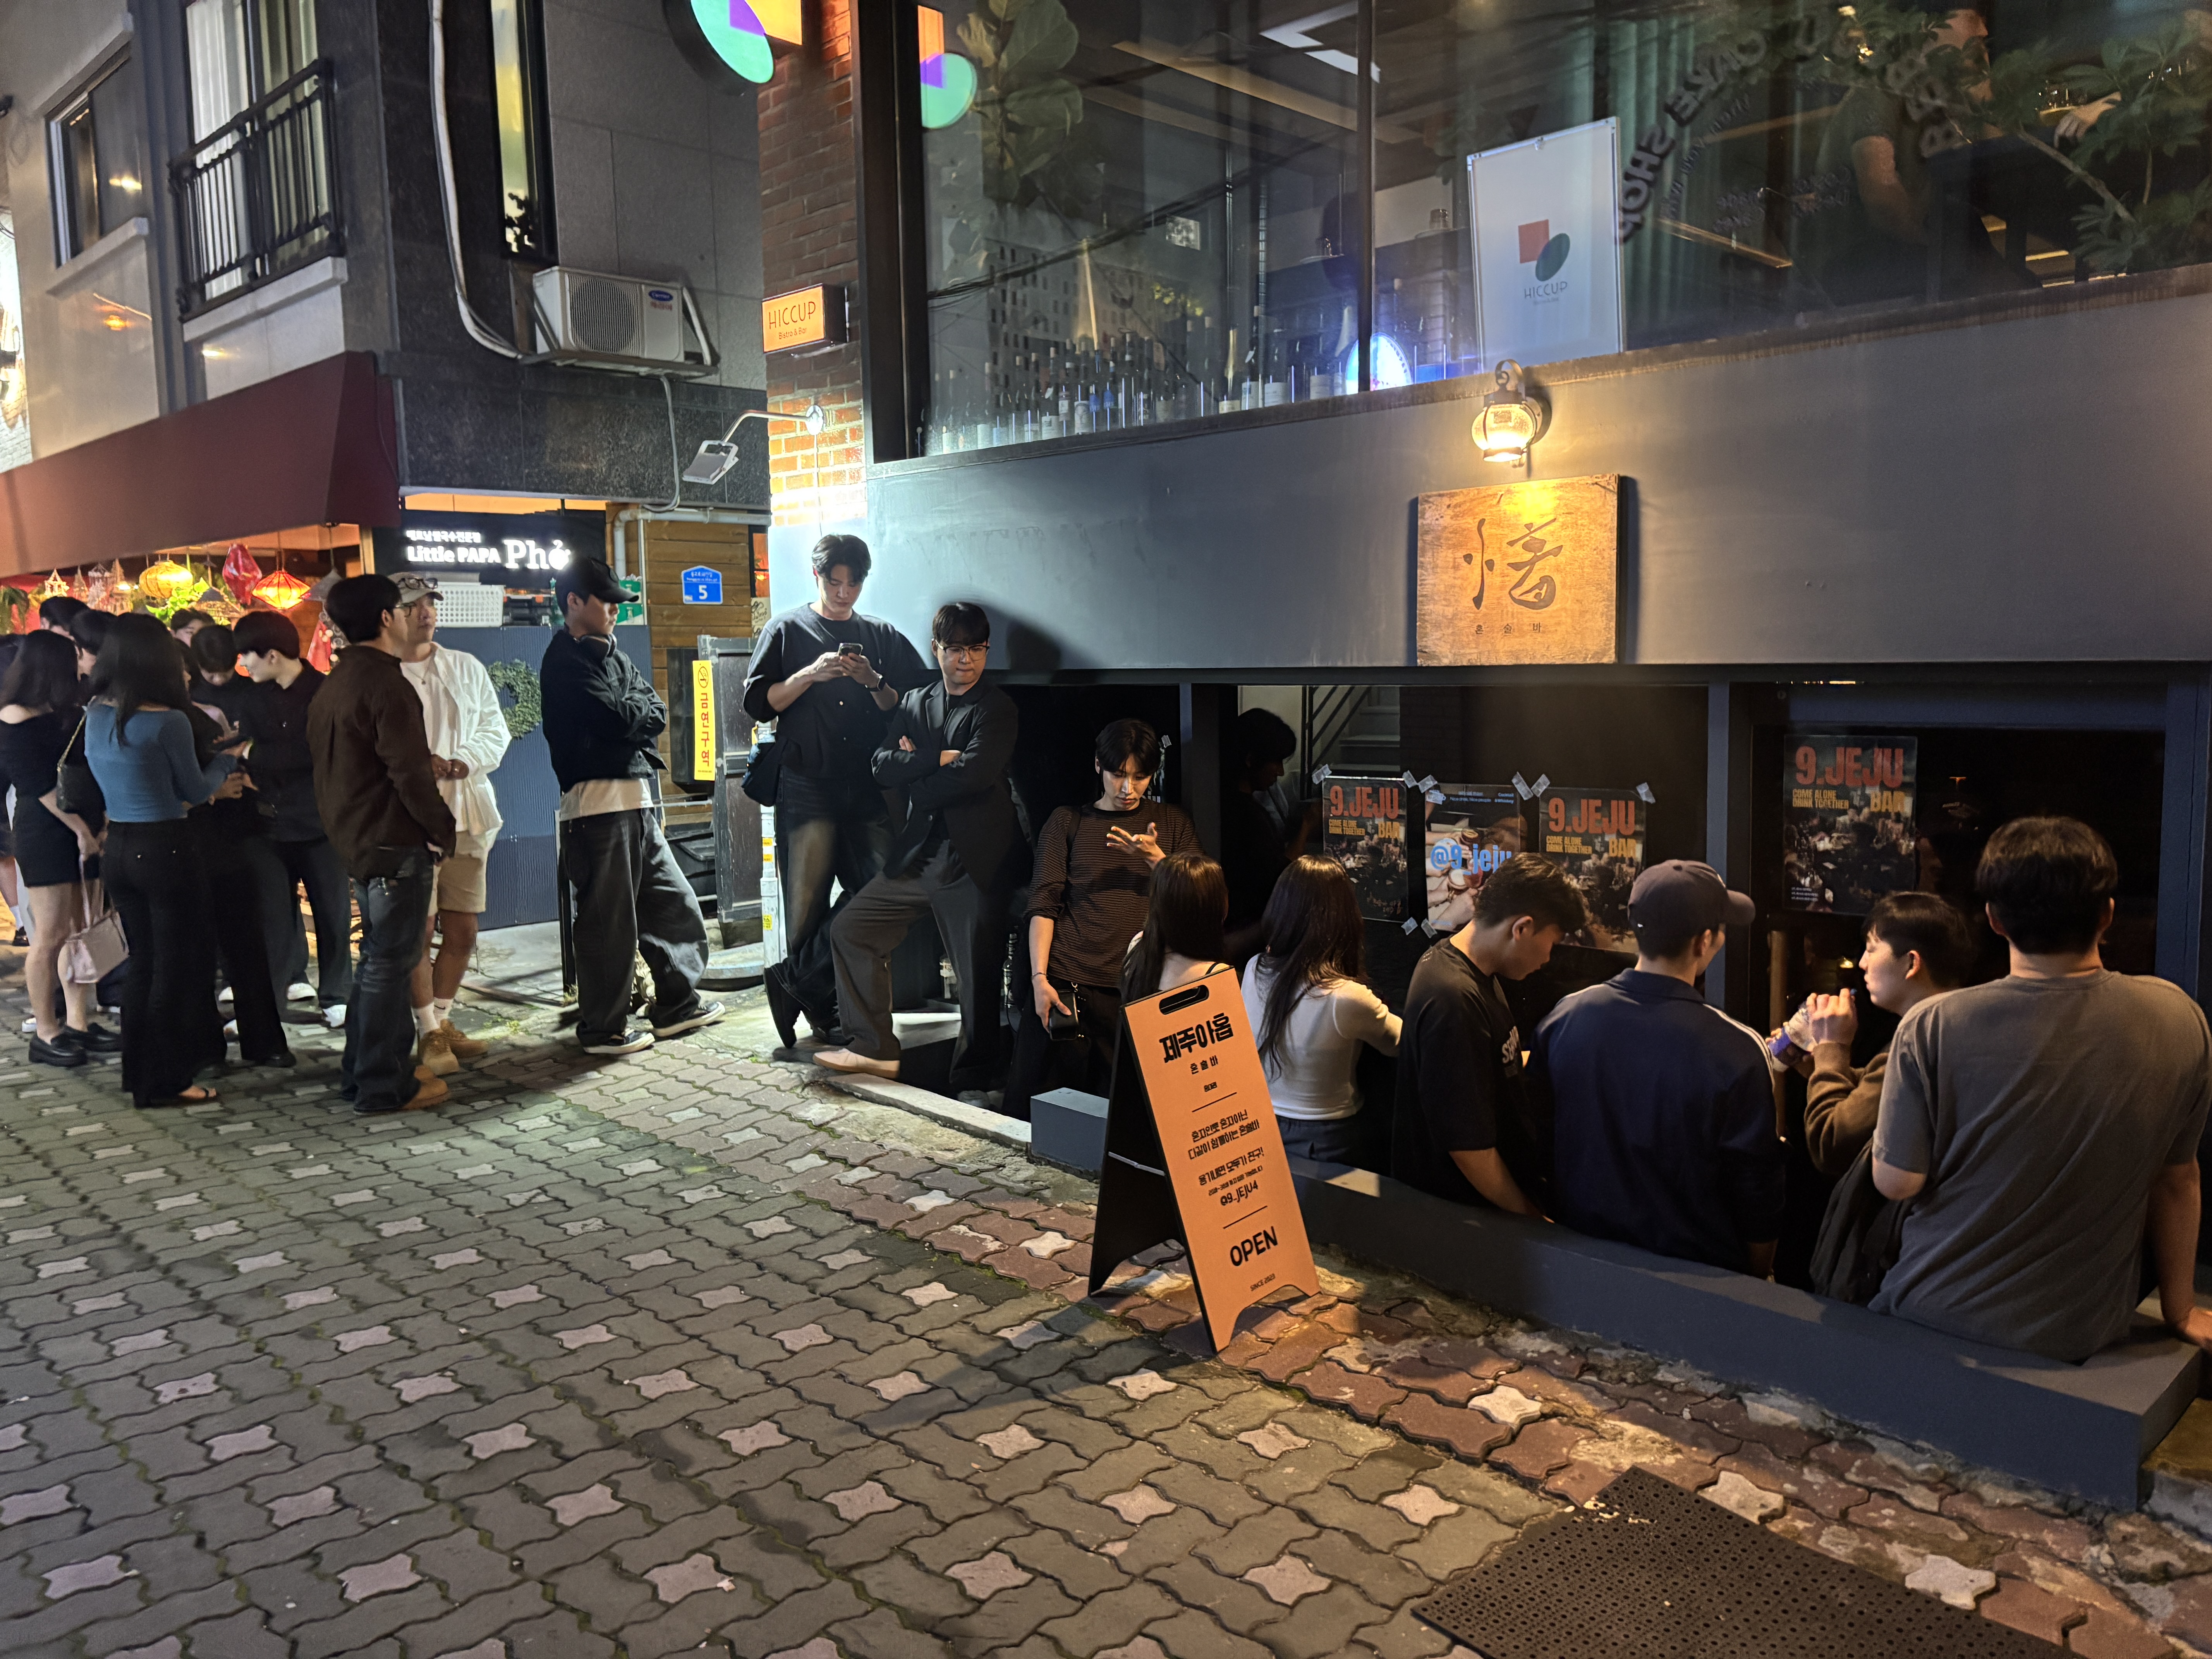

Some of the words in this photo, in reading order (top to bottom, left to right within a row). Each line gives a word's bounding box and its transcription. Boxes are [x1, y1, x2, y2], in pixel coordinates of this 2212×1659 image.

[1524, 281, 1568, 299] HICCUP
[769, 301, 816, 329] HICCUP
[407, 546, 455, 562] Little
[457, 547, 501, 563] PAPA
[699, 585, 708, 600] 5
[700, 692, 709, 767] 금연구역
[1795, 746, 1904, 788] 9.JEJU
[1330, 785, 1399, 819] 9.JEJU
[1792, 798, 1813, 808] DRINK
[1815, 799, 1849, 809] TOGETHER
[1793, 789, 1813, 799] COME
[1815, 789, 1837, 800] ALONE
[1870, 790, 1906, 812] BAR
[1343, 820, 1357, 828] ALONE
[1549, 797, 1635, 836] 9.JEJU
[1378, 821, 1400, 839] BAR
[1546, 836, 1563, 844] COME
[1565, 836, 1582, 845] ALONE
[1546, 844, 1563, 852] DRINK
[1565, 845, 1592, 854] TOGETHER
[1609, 838, 1637, 858] BAR
[1159, 1012, 1234, 1063] 제주아홉
[1220, 1109, 1249, 1130] 혼자아닌
[1188, 1141, 1211, 1160] 다같이
[1239, 1119, 1260, 1137] 혼술바
[1199, 1165, 1227, 1186] 용기내면
[1226, 1154, 1248, 1173] 모두가
[1247, 1147, 1264, 1163] 친구!
[1220, 1180, 1259, 1206] @9_JEJU4
[1230, 1226, 1278, 1266] OPEN
[1250, 1279, 1264, 1292] SINCE
